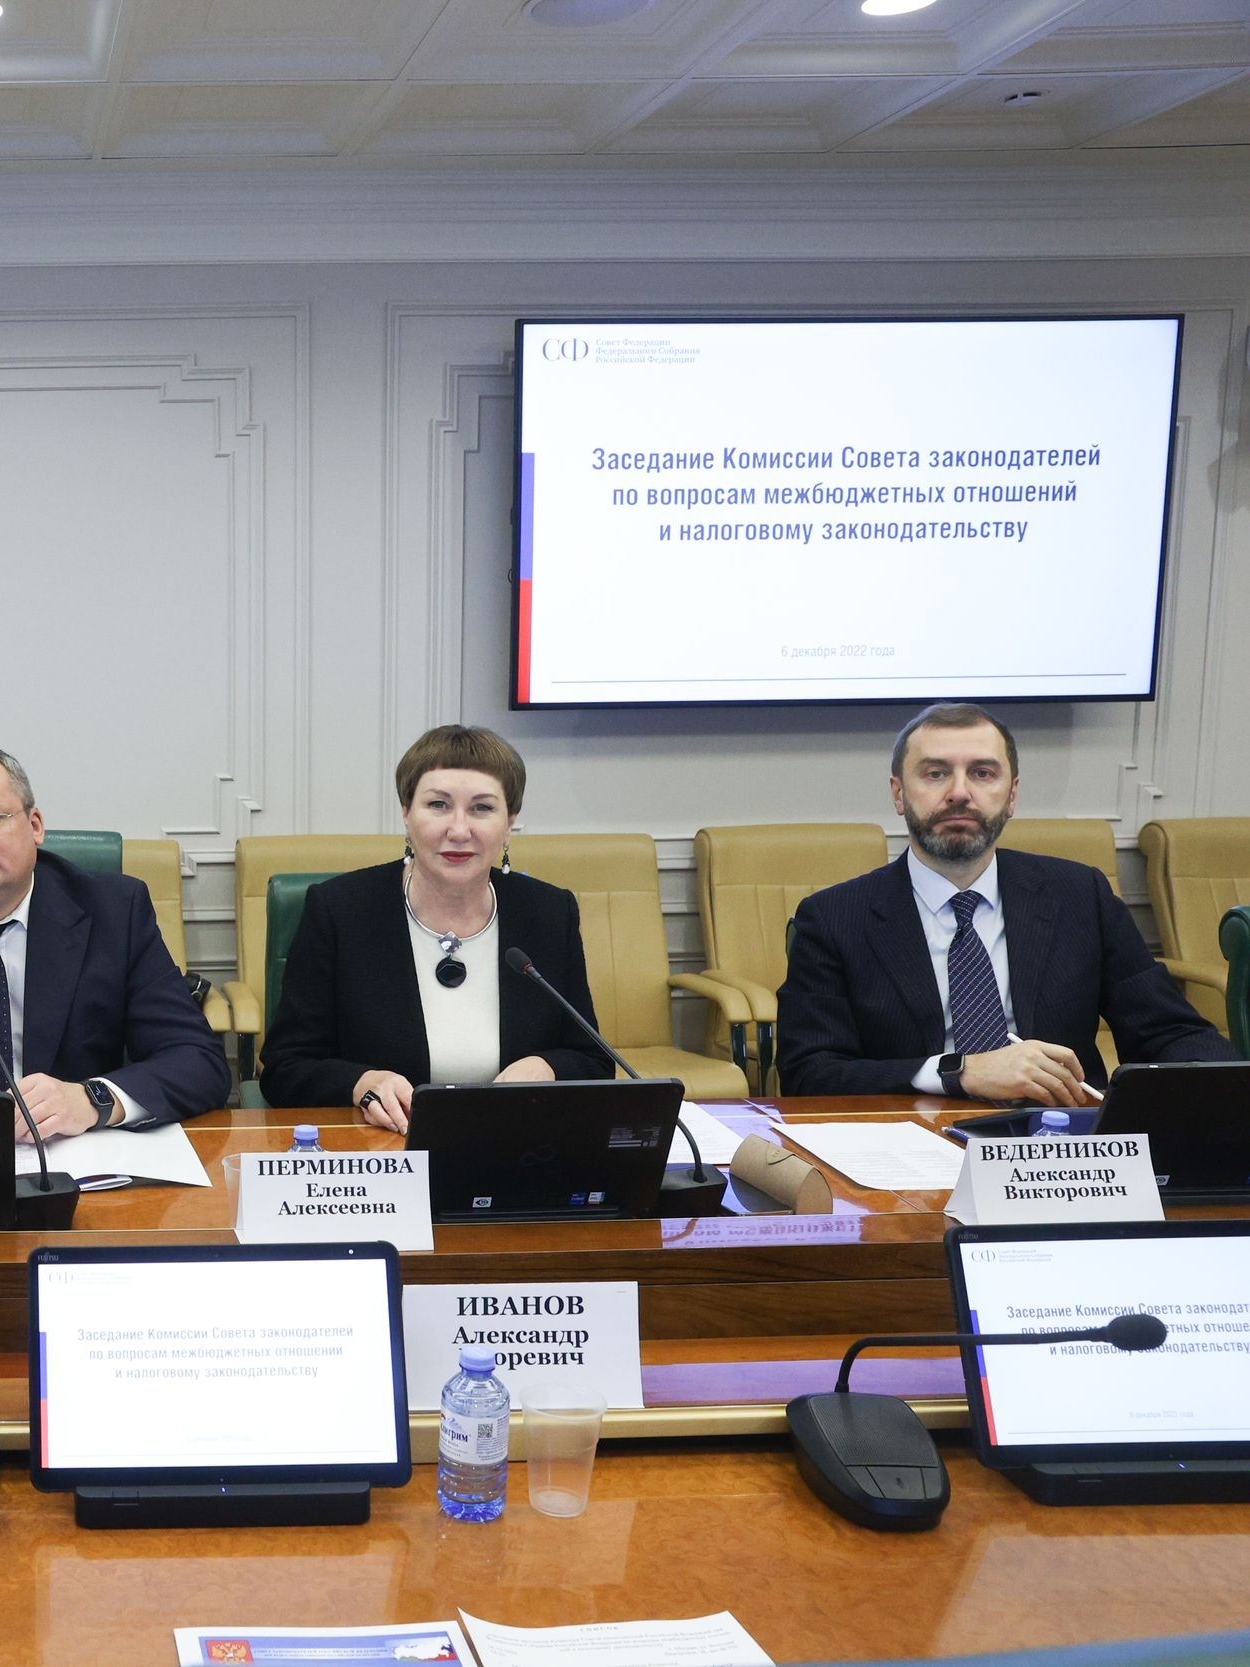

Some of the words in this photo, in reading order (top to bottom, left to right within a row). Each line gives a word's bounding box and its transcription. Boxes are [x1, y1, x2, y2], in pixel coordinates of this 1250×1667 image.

[542, 338, 588, 361] СФ
[592, 448, 714, 473] Заседание
[724, 448, 832, 469] Комиссии
[842, 447, 919, 468] Совета
[929, 444, 1100, 470] законодателей
[614, 489, 638, 505] по
[648, 488, 755, 510] вопросам
[765, 482, 945, 507] межбюджетных
[954, 481, 1076, 502] отношений
[660, 525, 670, 540] и
[680, 524, 813, 544] налоговому
[822, 522, 1028, 542] законодательству
[781, 645, 788, 657] 6
[791, 646, 836, 658] декабря
[840, 645, 867, 656] 2022
[871, 647, 894, 656] года
[981, 1141, 1138, 1162] ВЕДЕРНИКОВ
[258, 1158, 414, 1175] ПЕРМИНОВА
[1010, 1168, 1115, 1183] Александр
[307, 1184, 367, 1197] Елена
[1004, 1186, 1127, 1201] Викторович
[278, 1201, 396, 1215] Алексеевна
[457, 1296, 584, 1316] ИВАНОВ
[1007, 1306, 1072, 1319] Заседание
[1075, 1304, 1135, 1317] Комиссии
[1139, 1303, 1182, 1315] Совета
[78, 1329, 144, 1342] Заседание
[148, 1328, 208, 1340] Комиссии
[212, 1327, 256, 1339] Совета
[260, 1328, 353, 1339] законодателей
[452, 1326, 589, 1348] Александр
[89, 1350, 103, 1360] по
[108, 1349, 167, 1361] вопросам
[171, 1347, 270, 1360] межбюджетных
[494, 1350, 584, 1370] оревич
[115, 1369, 122, 1378] и
[126, 1368, 200, 1380] налоговому
[205, 1366, 318, 1378] законодательству
